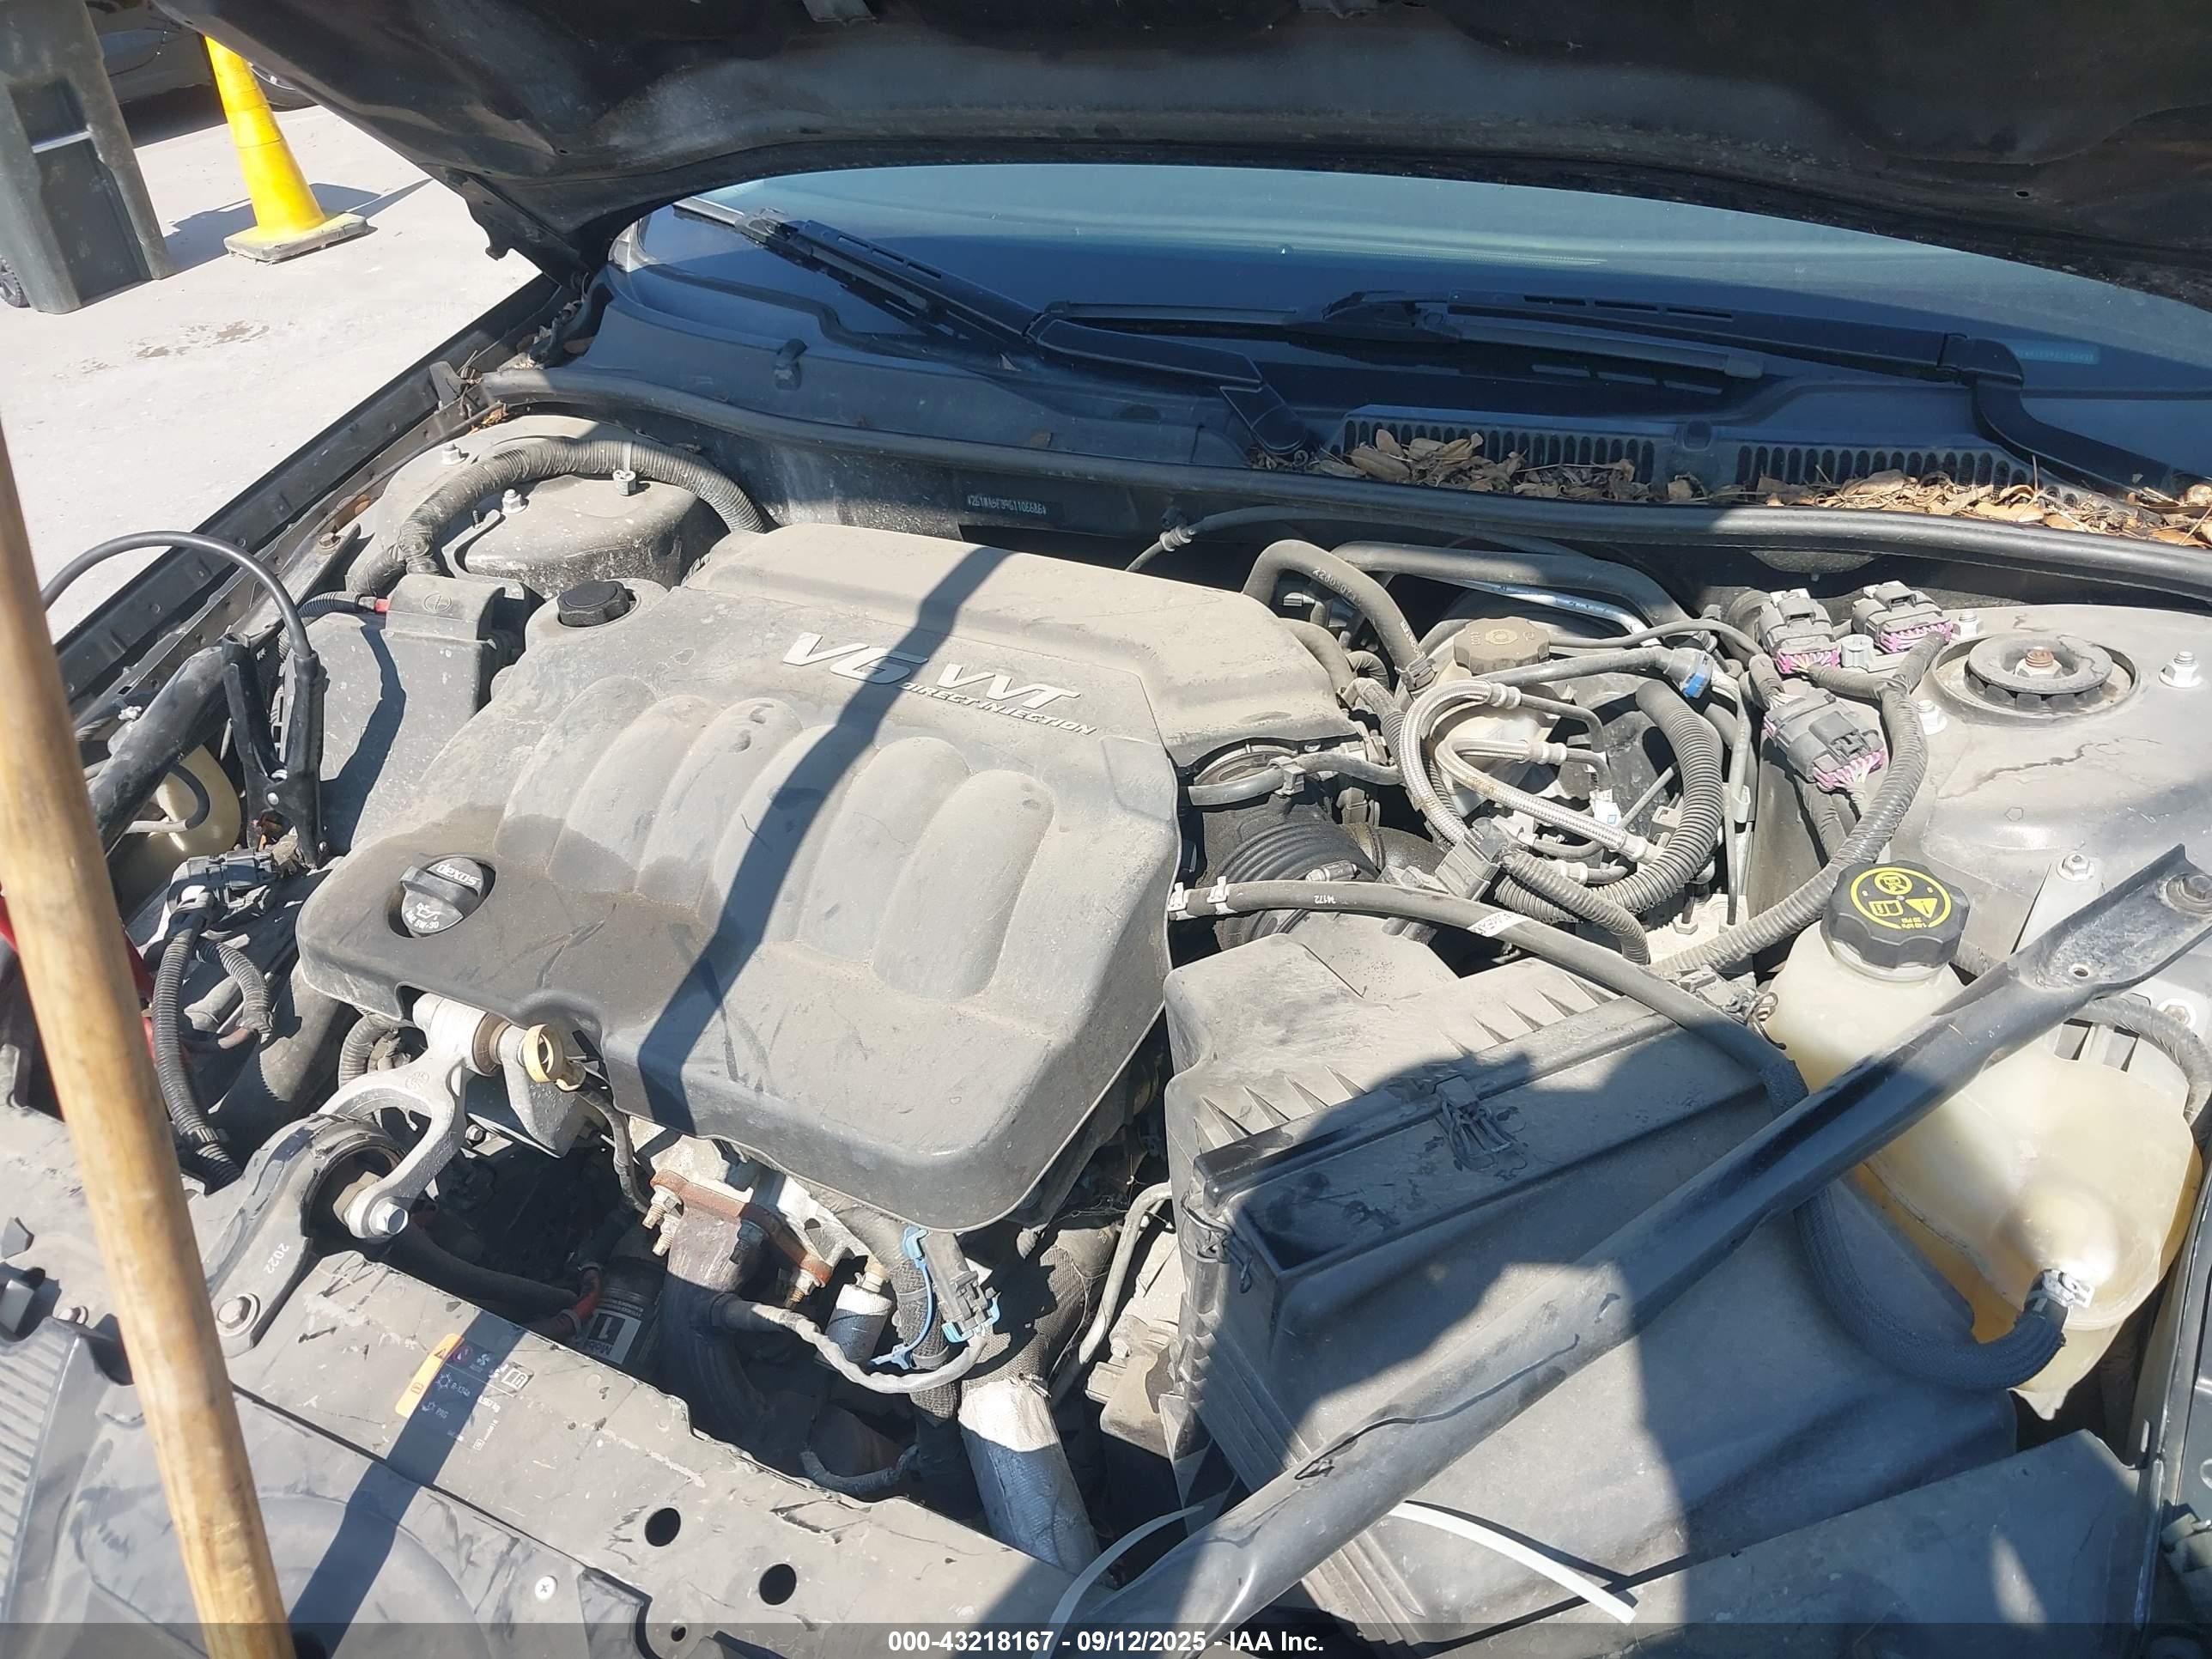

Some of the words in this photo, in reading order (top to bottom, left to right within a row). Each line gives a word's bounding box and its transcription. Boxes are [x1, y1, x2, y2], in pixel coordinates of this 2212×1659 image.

[782, 632, 930, 684] V6
[937, 663, 1080, 710] VVT
[901, 681, 979, 708] DIRECT
[978, 699, 1098, 737] INJECTION
[436, 863, 481, 886] dexos
